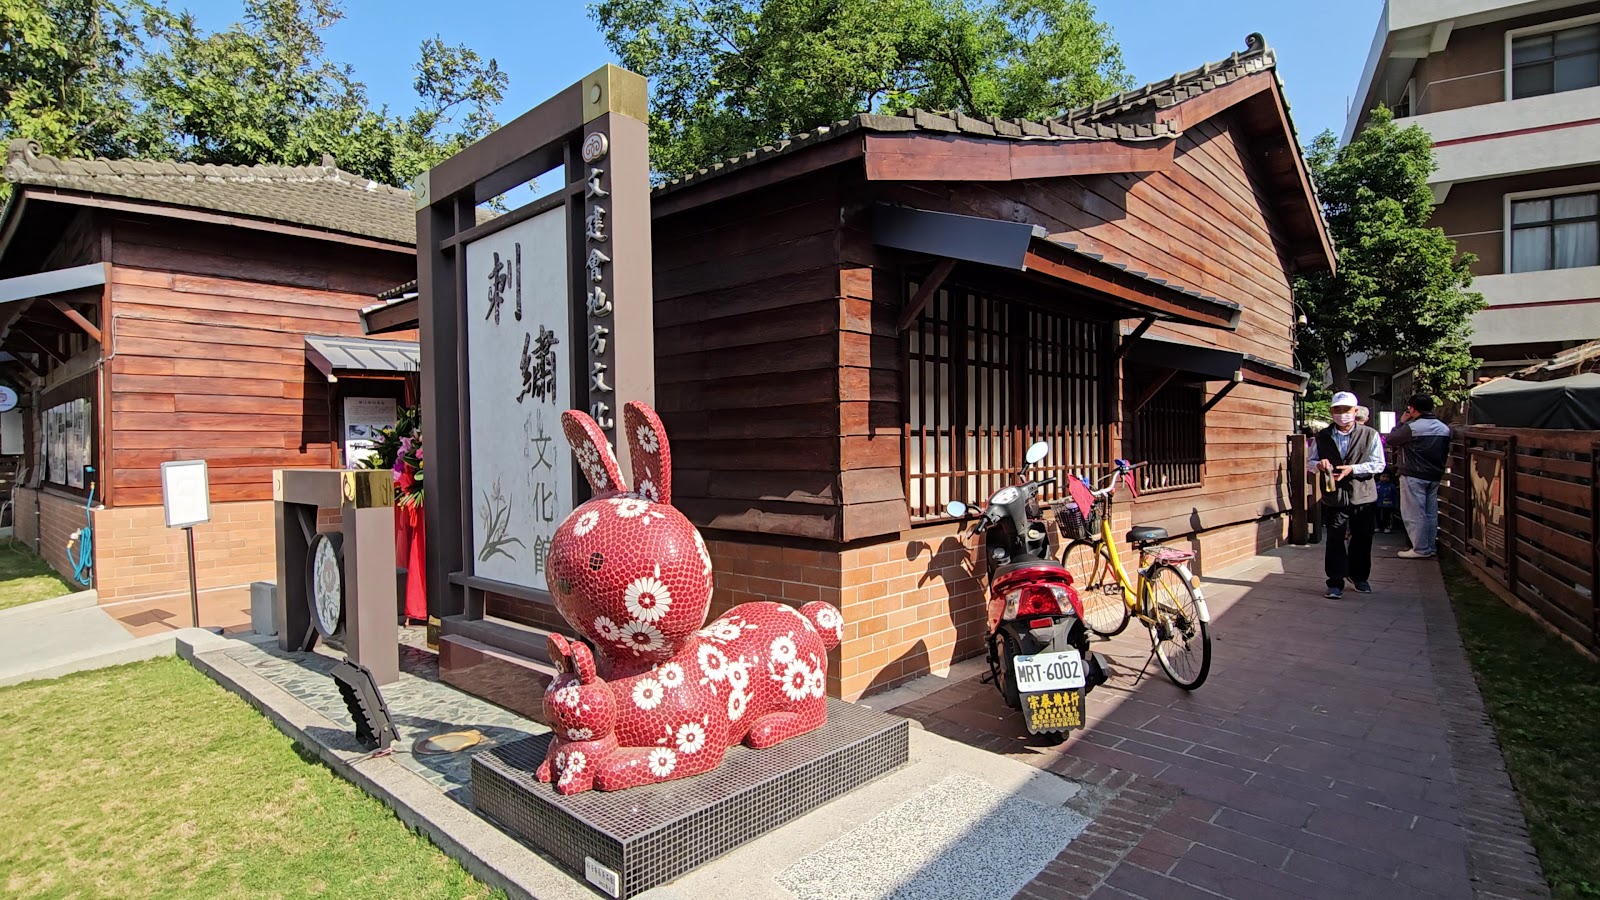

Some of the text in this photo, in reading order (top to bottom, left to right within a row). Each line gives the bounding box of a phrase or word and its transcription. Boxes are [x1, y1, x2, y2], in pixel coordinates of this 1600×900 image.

[585, 167, 614, 448] 文建會地方文化
